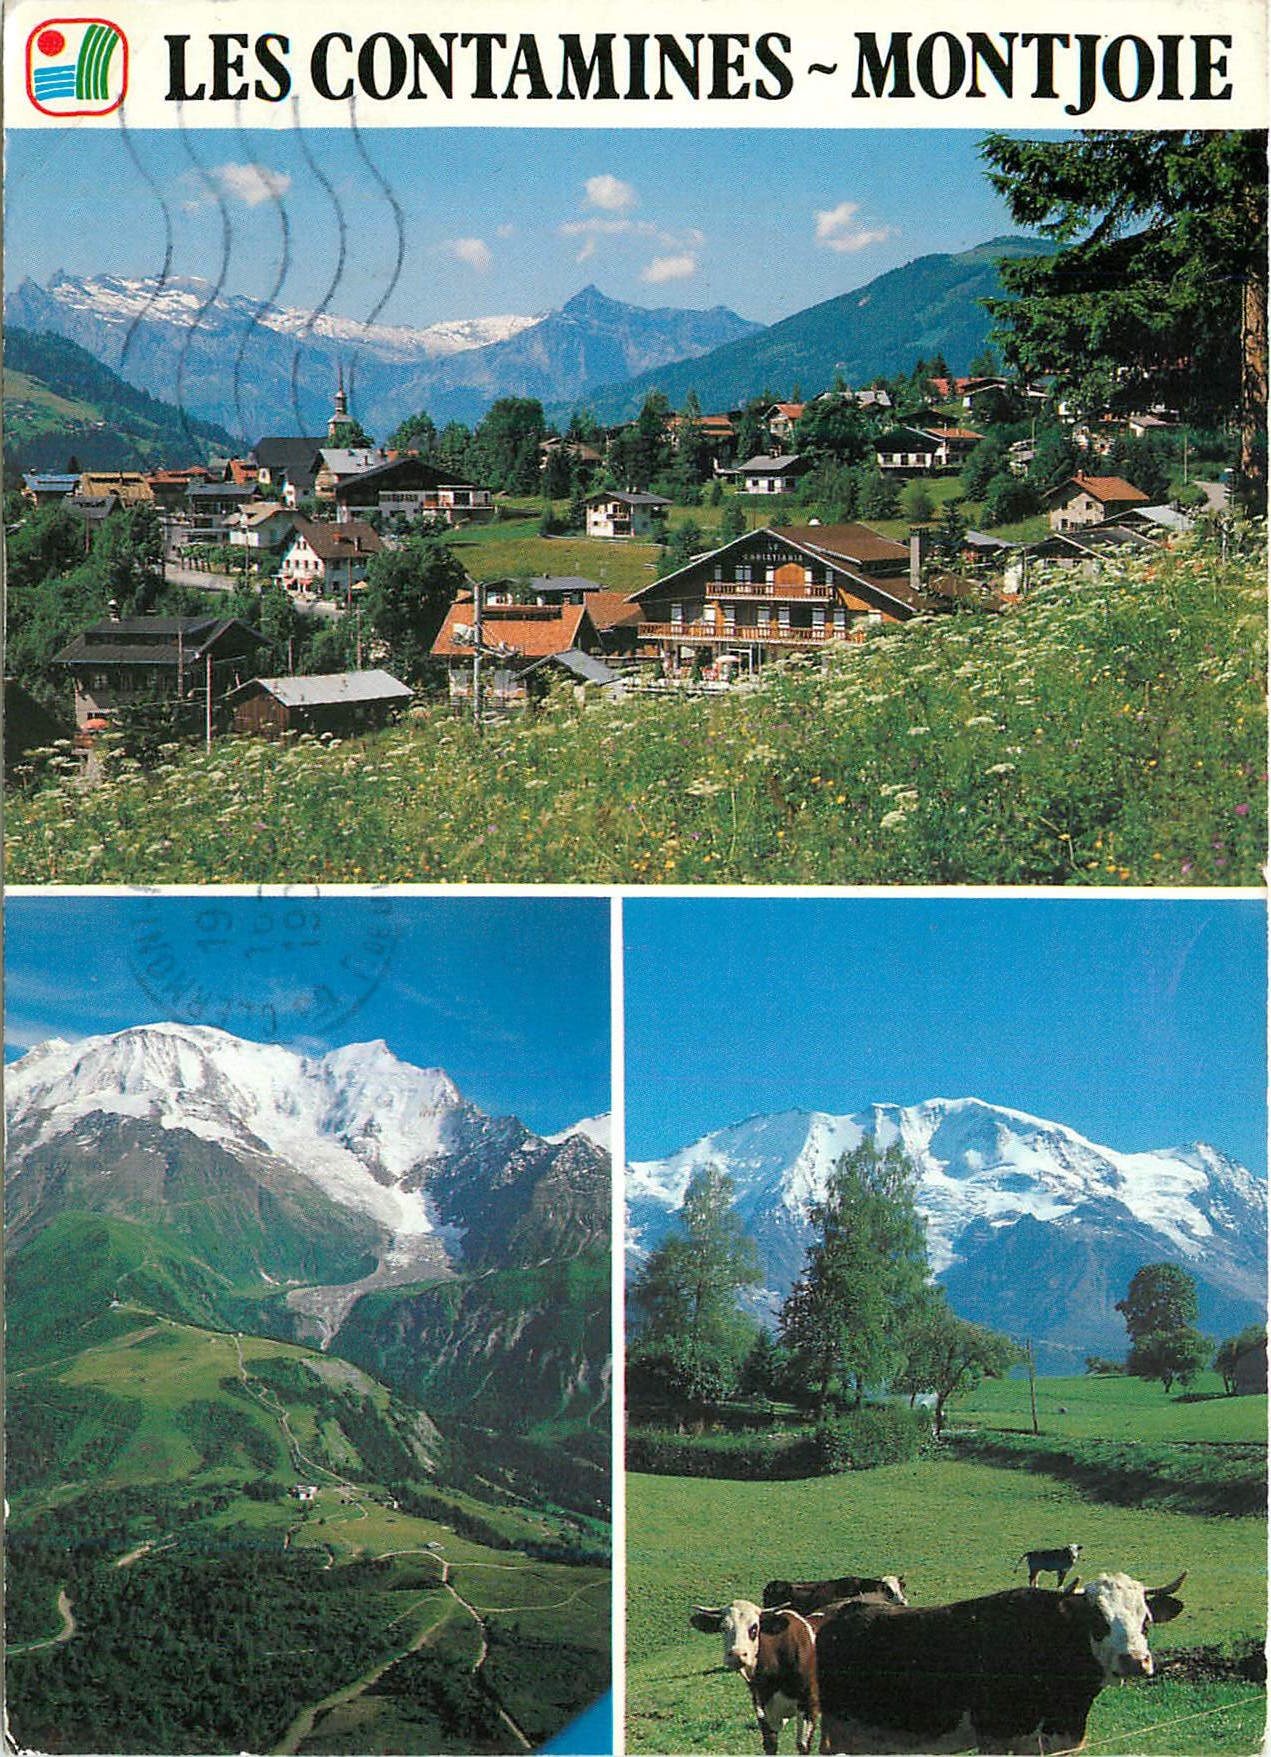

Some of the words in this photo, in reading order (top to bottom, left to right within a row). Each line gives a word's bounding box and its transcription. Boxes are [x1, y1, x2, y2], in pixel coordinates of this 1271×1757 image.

[163, 33, 292, 102] LES
[310, 32, 793, 100] CONTAMINES
[851, 32, 1233, 113] MONTJOIE
